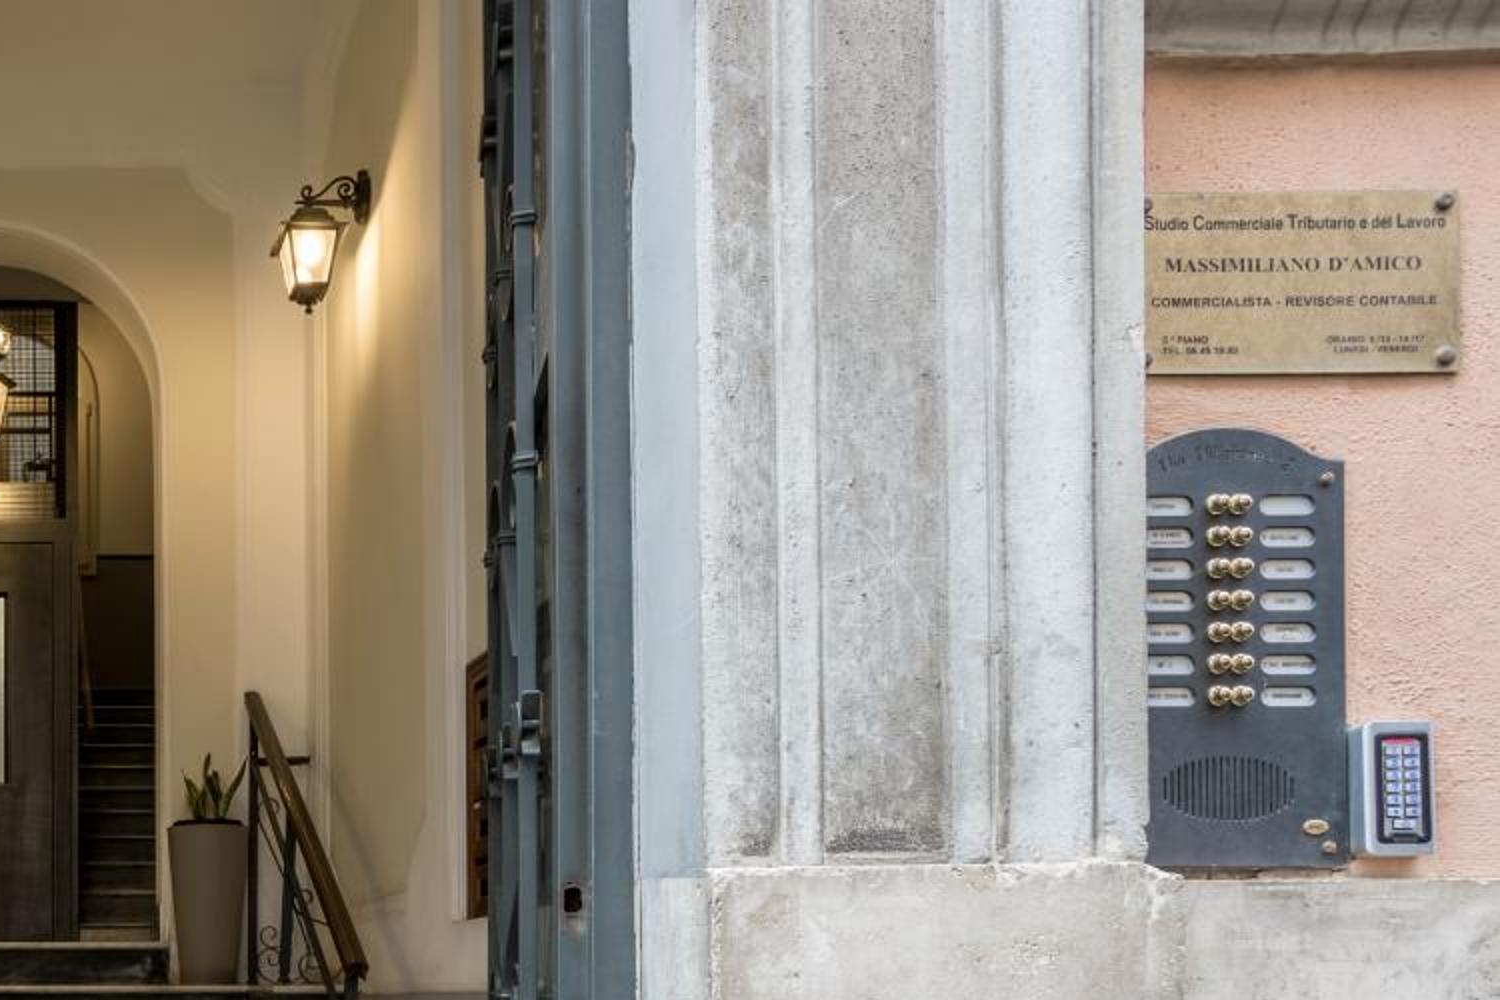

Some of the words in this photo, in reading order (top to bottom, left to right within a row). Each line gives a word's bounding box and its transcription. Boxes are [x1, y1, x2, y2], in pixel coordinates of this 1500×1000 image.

[1144, 215, 1189, 231] Studio
[1193, 214, 1284, 231] Commerciale
[1286, 213, 1356, 230] Tributario
[1359, 217, 1368, 229] e
[1371, 214, 1393, 229] del
[1396, 213, 1446, 229] Lavoro
[1164, 257, 1321, 273] MASSIMILIANO
[1329, 255, 1423, 272] D'AMICO
[1151, 296, 1273, 308] COMMERCIALISTA
[1285, 295, 1355, 307] REVISORE
[1358, 294, 1438, 307] CONTABILE
